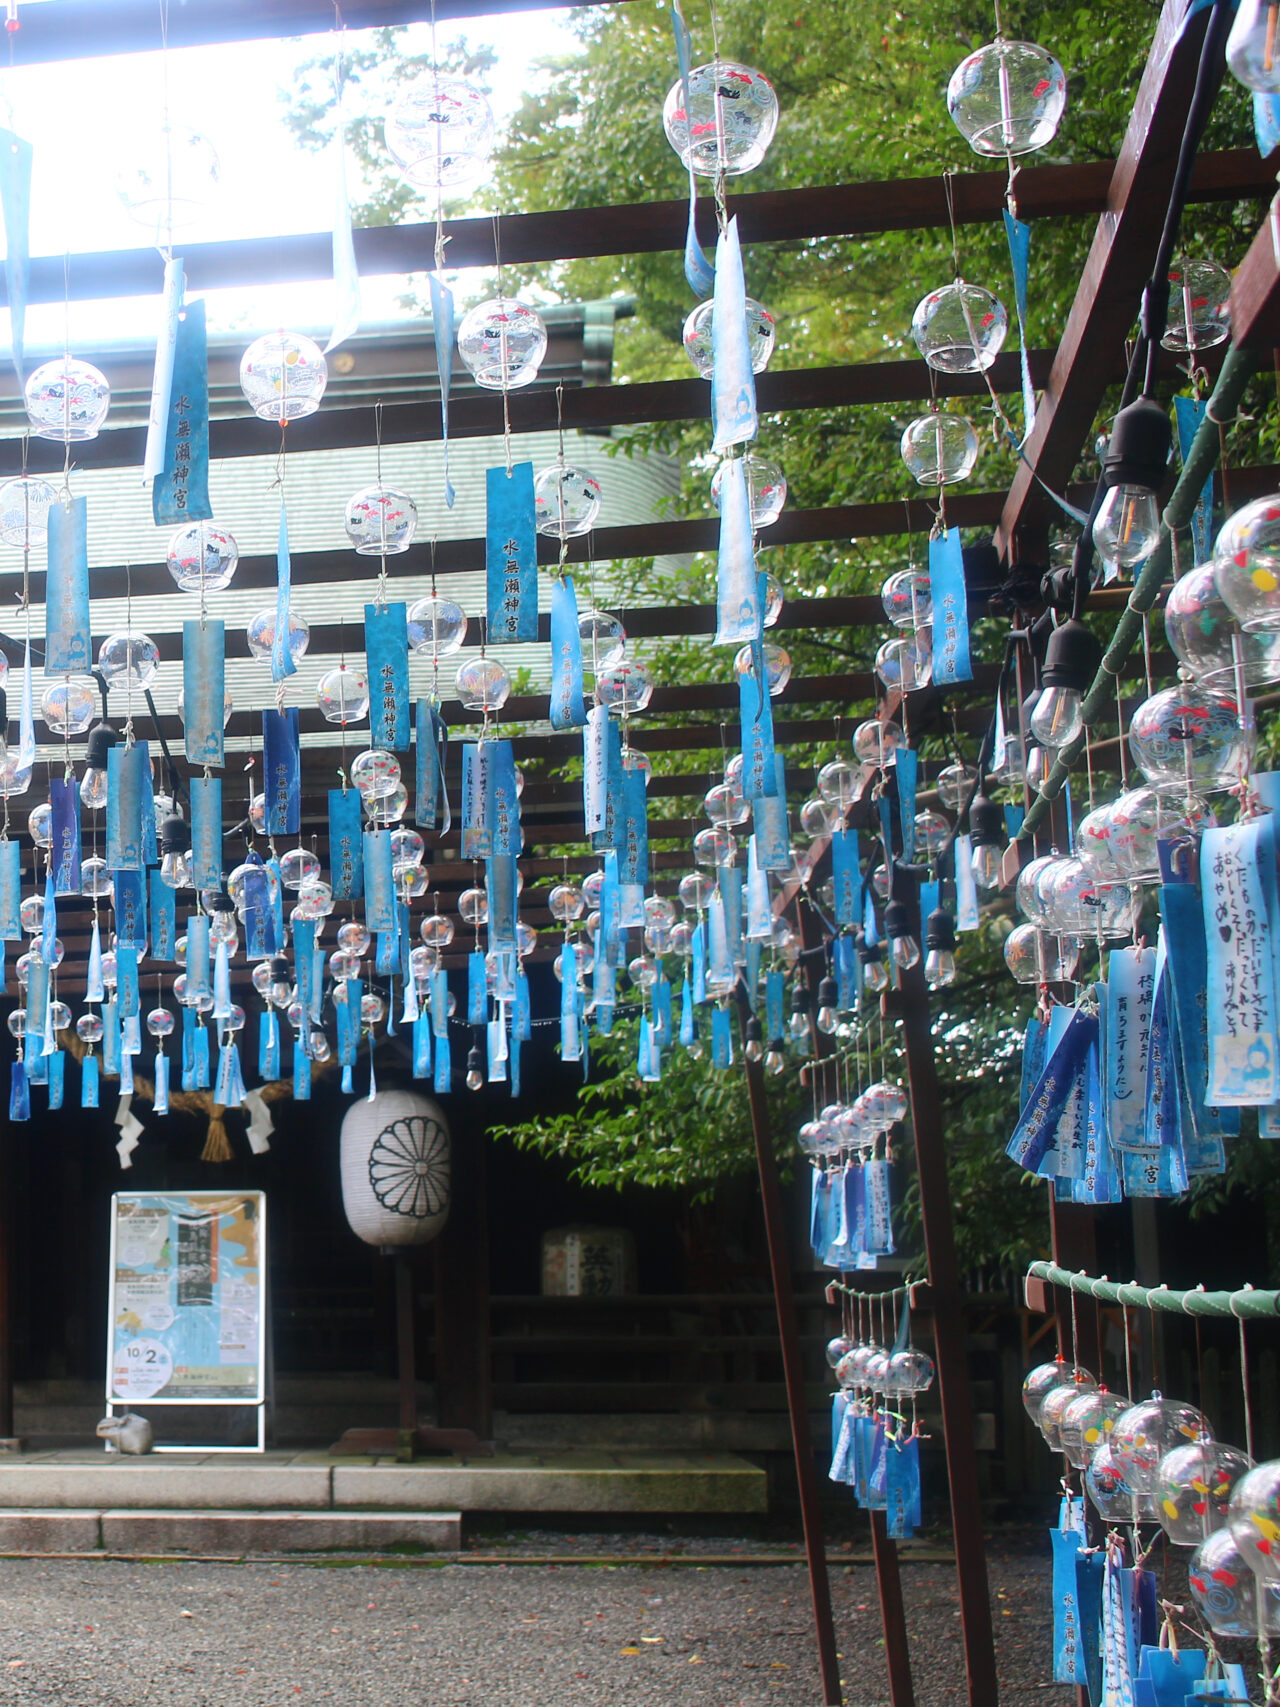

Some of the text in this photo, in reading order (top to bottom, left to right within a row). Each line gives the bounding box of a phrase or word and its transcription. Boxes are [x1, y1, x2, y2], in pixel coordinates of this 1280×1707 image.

[502, 538, 521, 633] 水無瀬神宮
[380, 663, 397, 742] 水無瀬神宮
